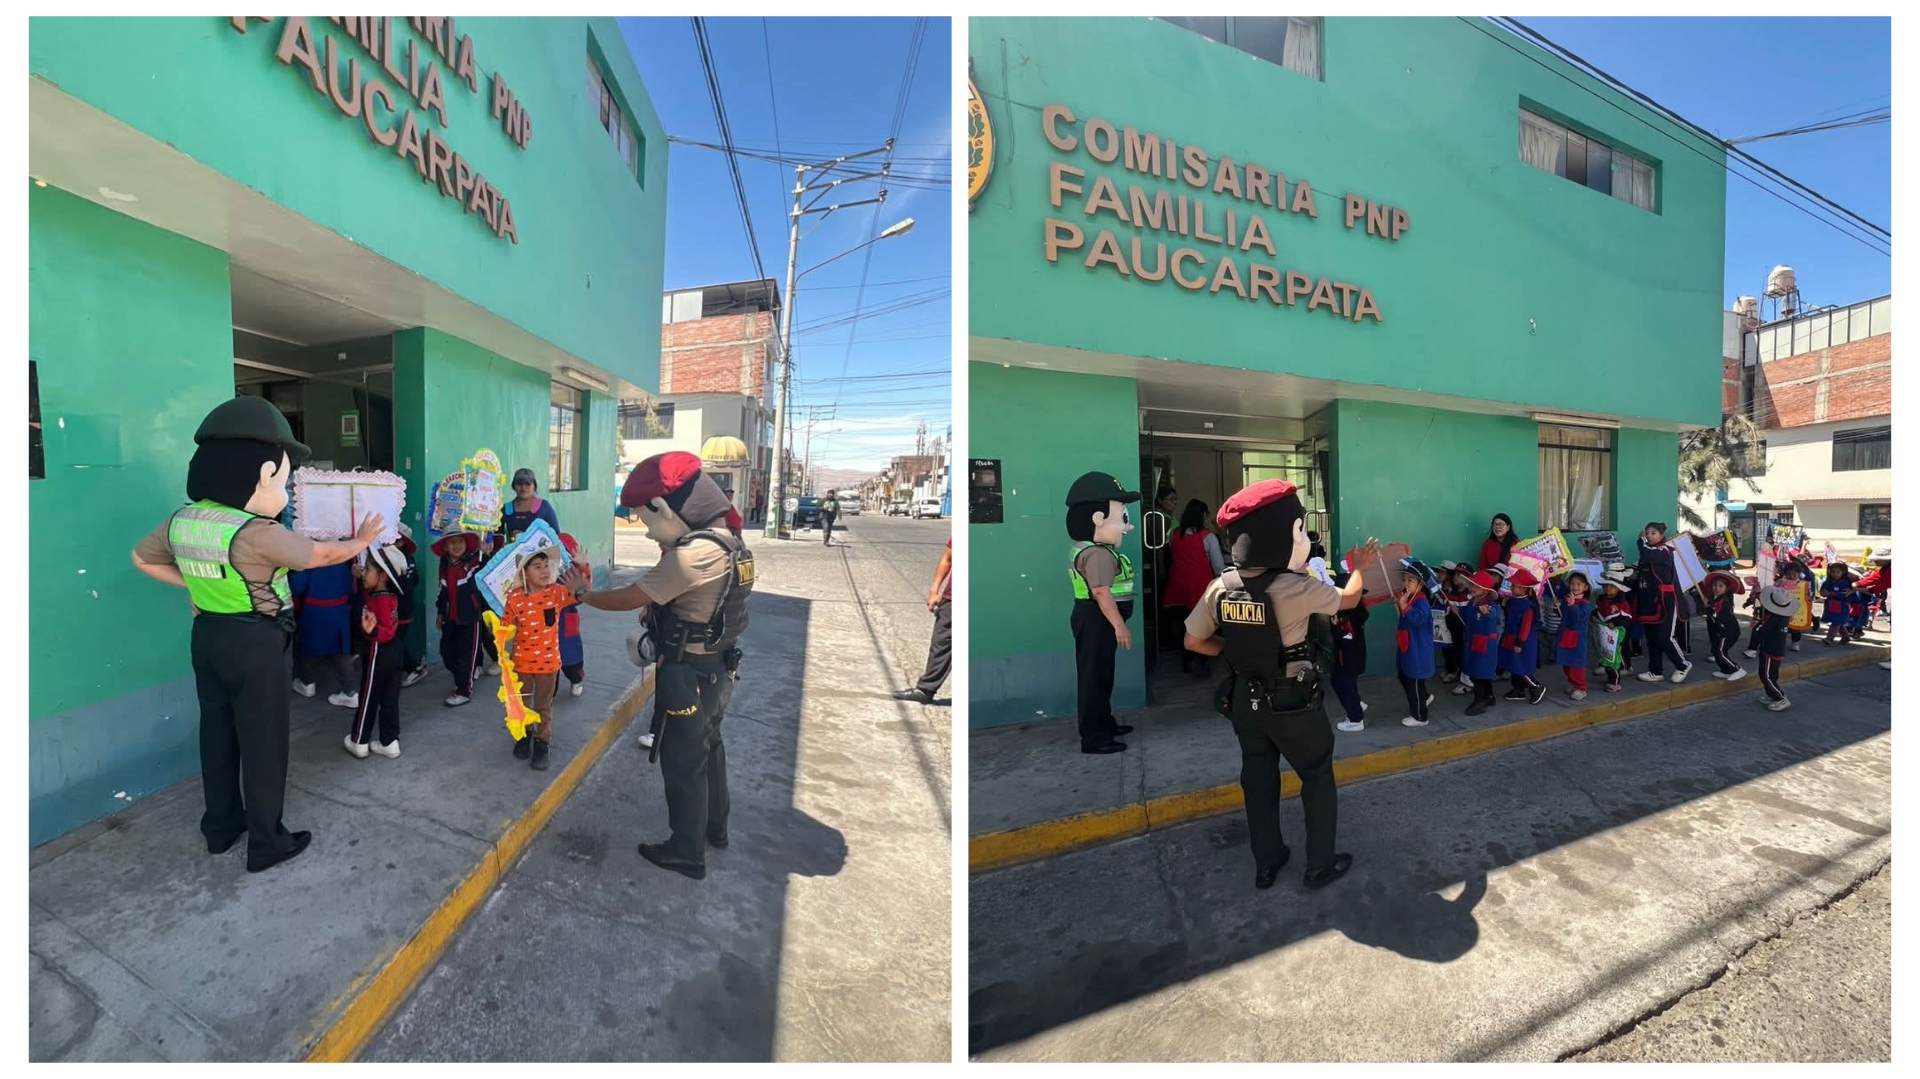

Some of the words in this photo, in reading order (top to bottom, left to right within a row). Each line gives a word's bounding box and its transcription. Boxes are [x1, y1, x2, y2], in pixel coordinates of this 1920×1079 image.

[492, 71, 533, 150] PNP
[1041, 103, 1318, 218] COMISARIA
[1344, 190, 1410, 241] PNP
[1049, 161, 1277, 256] FAMILIA
[1044, 217, 1384, 322] PAUCARPATA
[1223, 602, 1263, 622] POLICIA
